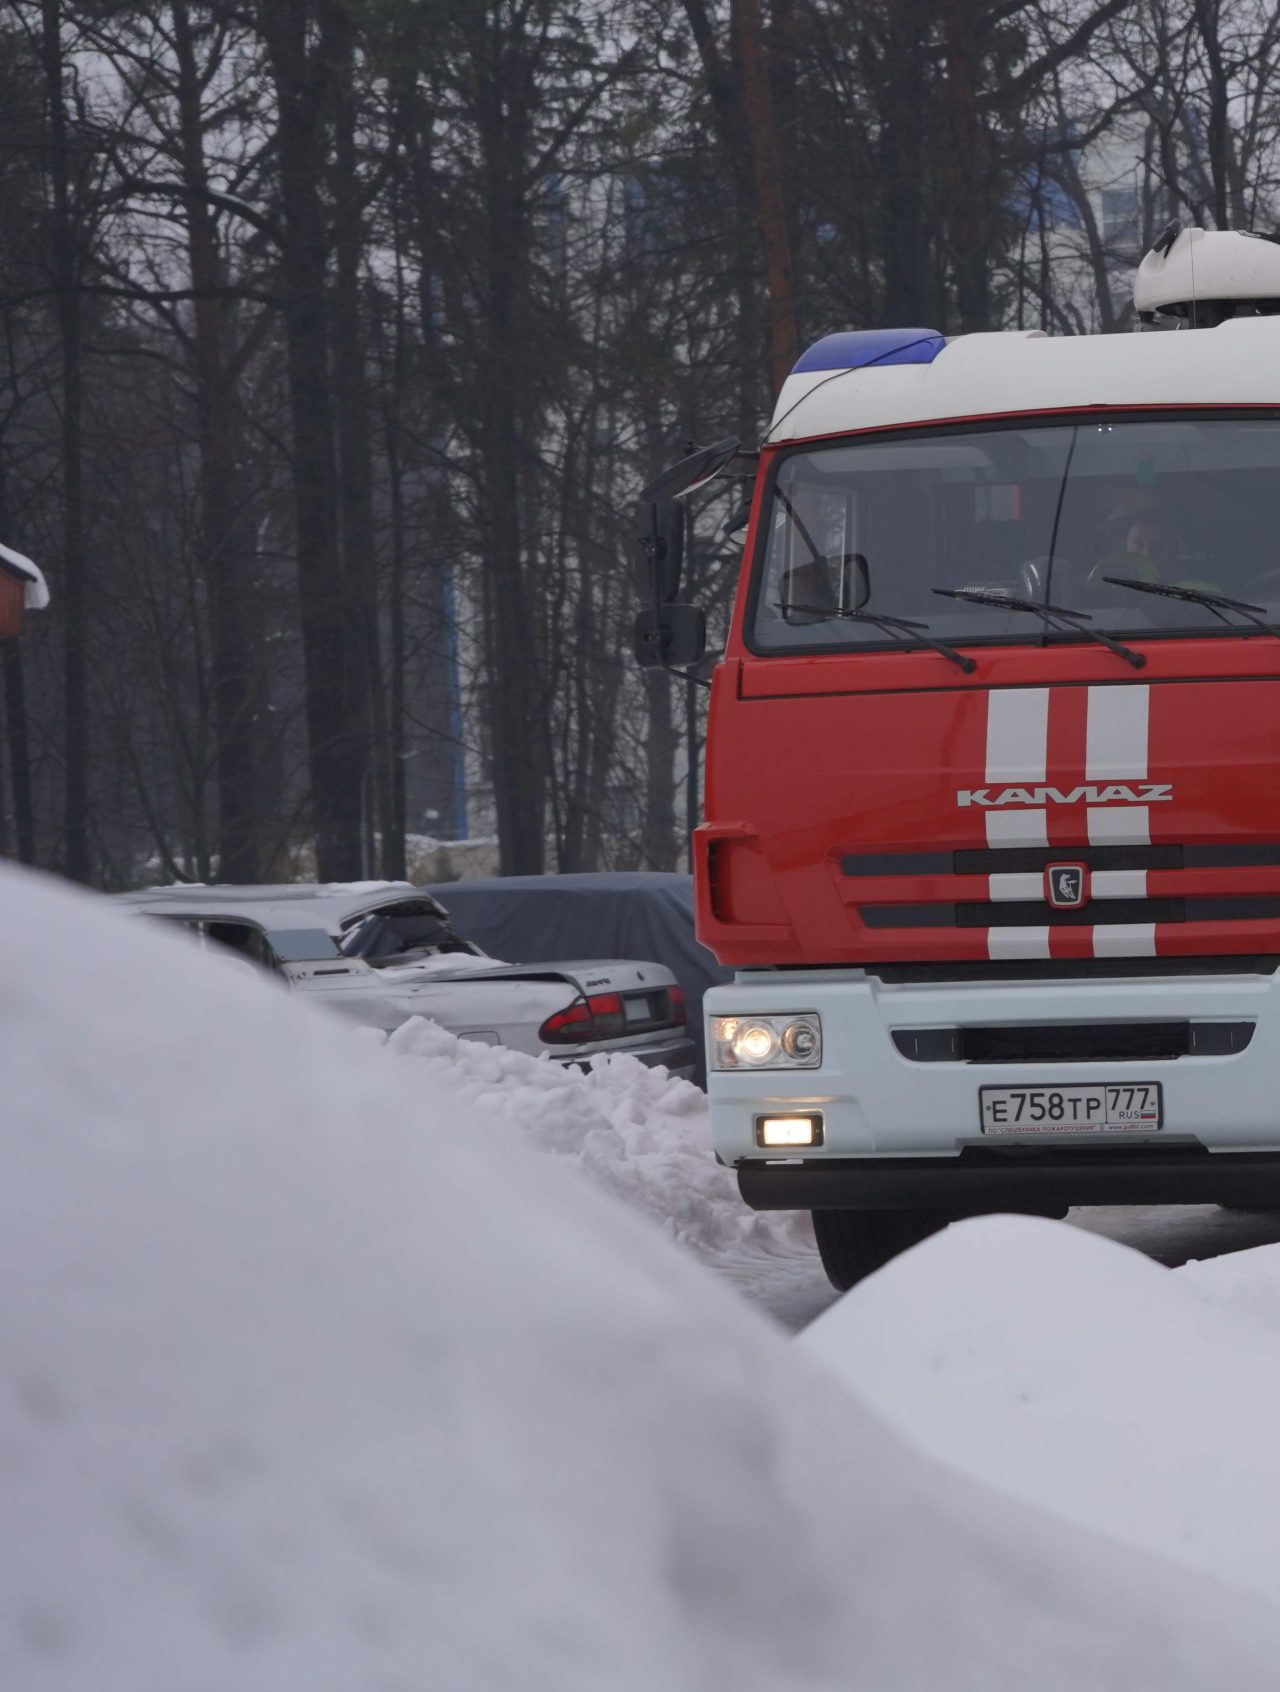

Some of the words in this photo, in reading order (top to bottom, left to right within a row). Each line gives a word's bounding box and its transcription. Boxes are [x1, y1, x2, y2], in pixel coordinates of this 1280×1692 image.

[957, 784, 1173, 807] KAMAZ
[1108, 1088, 1150, 1110] 777
[1119, 1111, 1140, 1119] RUS
